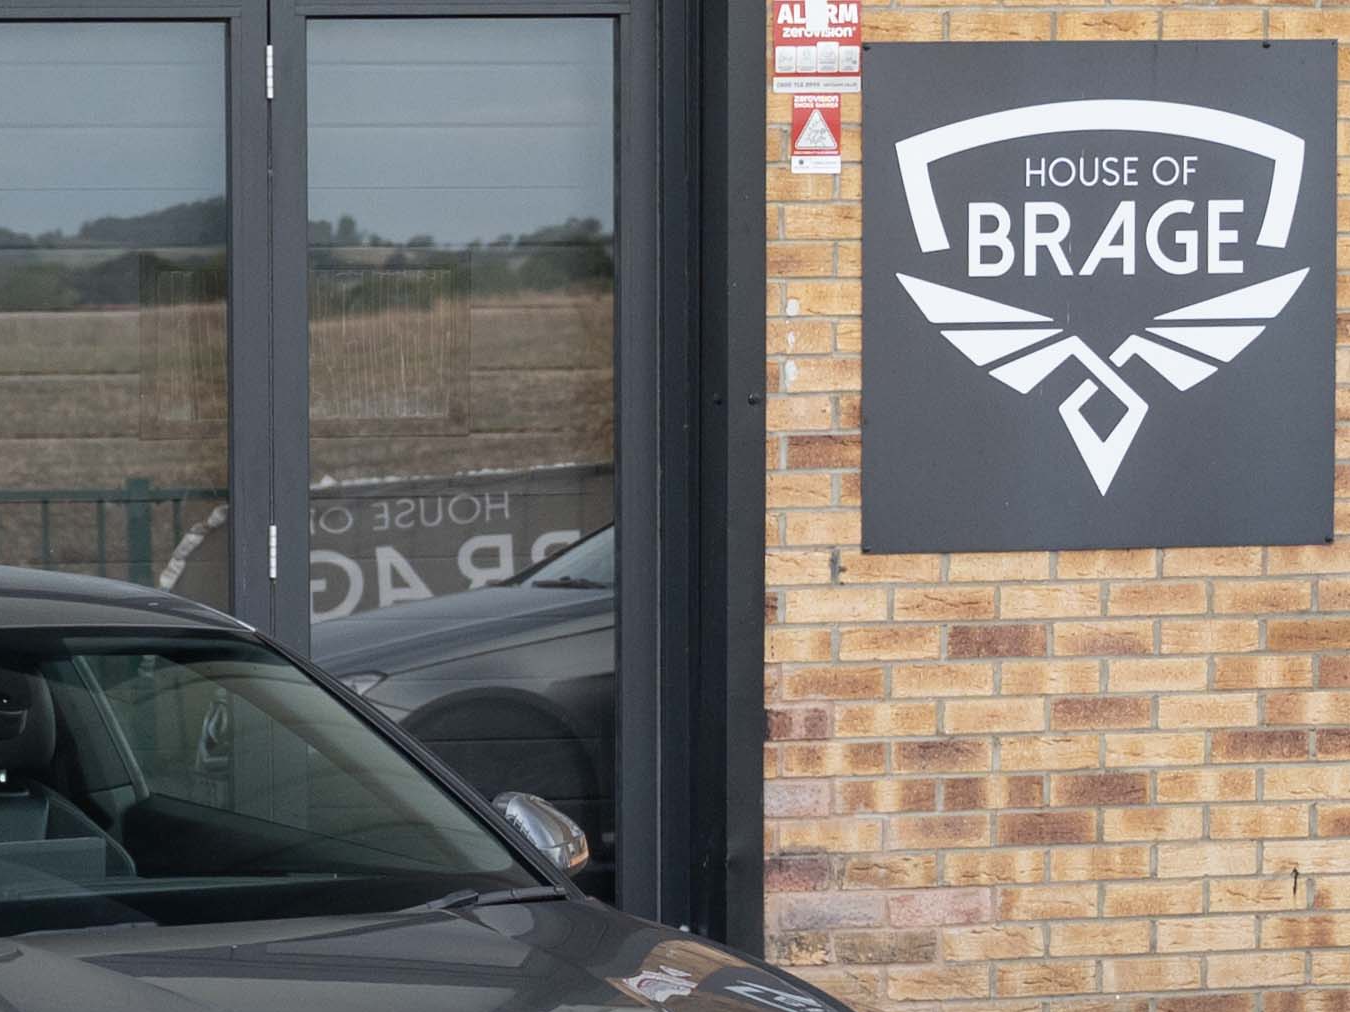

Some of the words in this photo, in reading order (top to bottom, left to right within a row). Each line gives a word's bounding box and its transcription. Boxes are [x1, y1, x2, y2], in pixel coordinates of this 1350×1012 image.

[777, 3, 858, 25] ALRM
[1026, 157, 1138, 186] HOUSE
[1153, 156, 1197, 185] OF
[969, 200, 1243, 276] BRAGE
